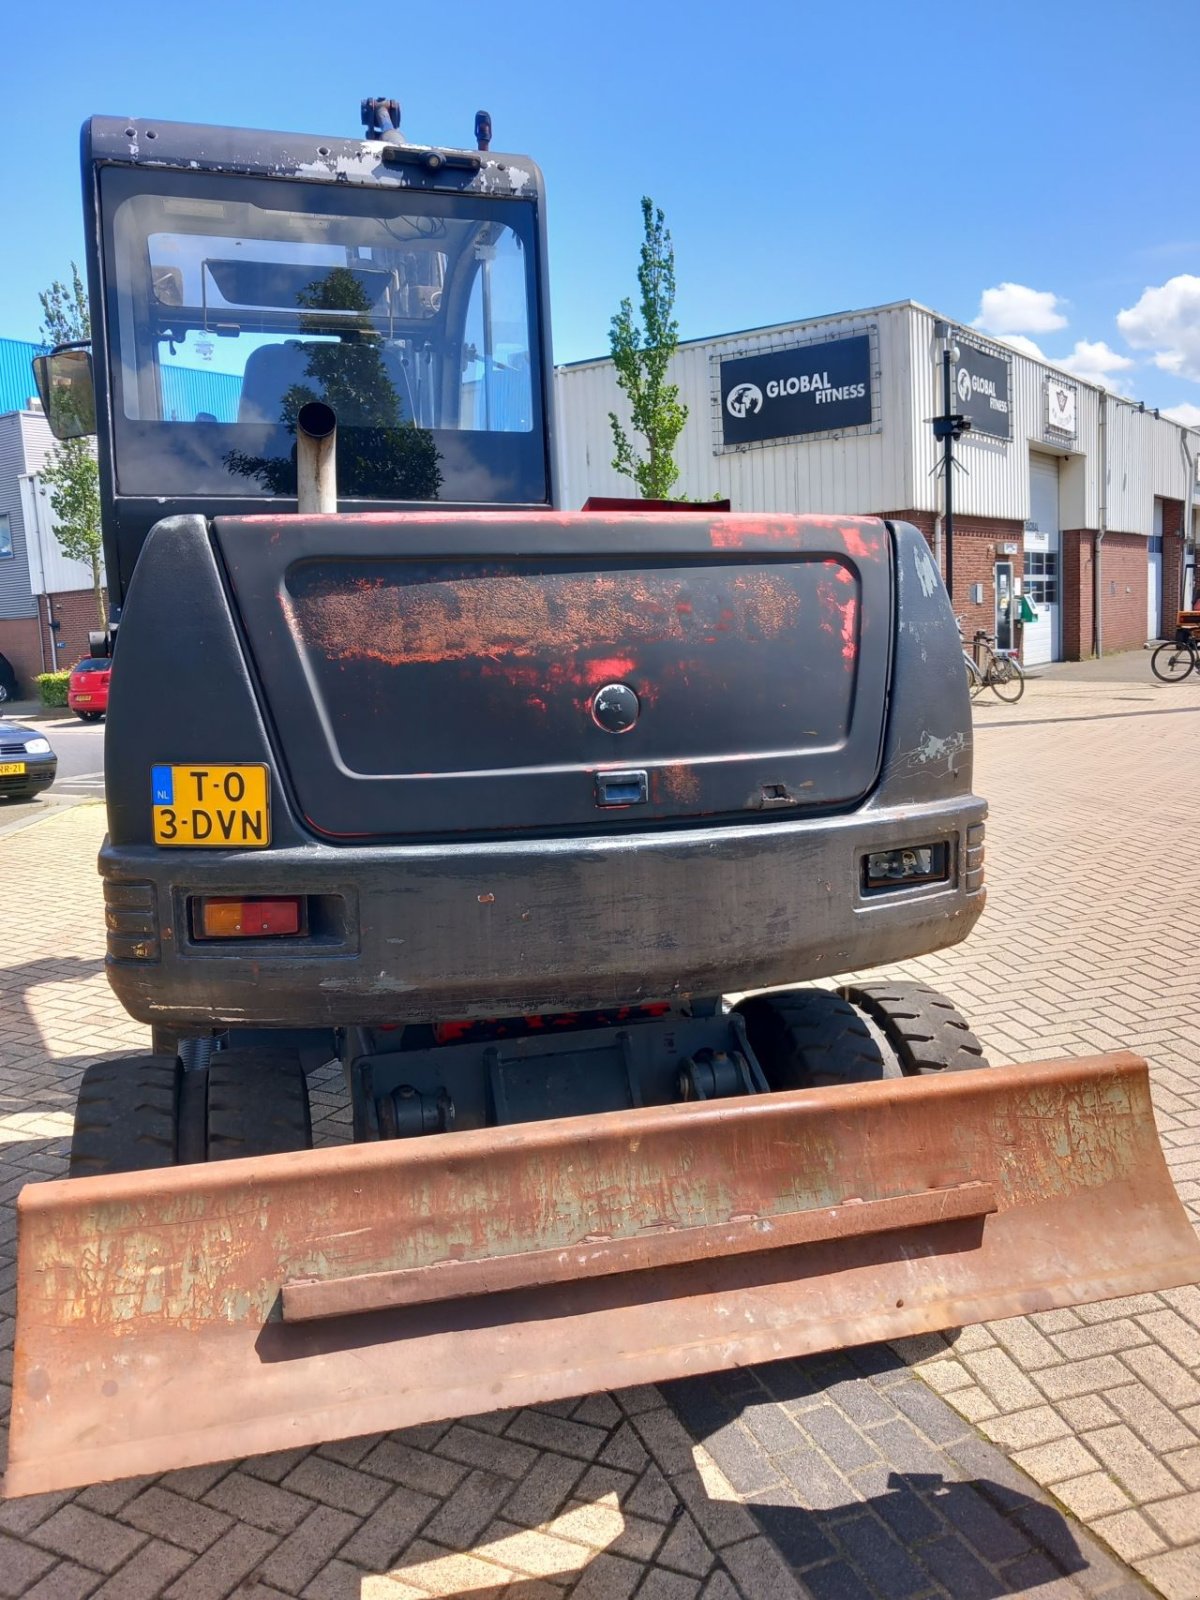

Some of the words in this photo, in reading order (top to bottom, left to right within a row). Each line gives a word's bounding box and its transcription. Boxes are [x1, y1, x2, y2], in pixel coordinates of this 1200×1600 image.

[766, 372, 831, 398] GLOBAL
[815, 383, 866, 404] FITNESS
[971, 375, 996, 397] GLOBAL
[157, 790, 169, 799] NL
[160, 809, 262, 840] 3-DVN
